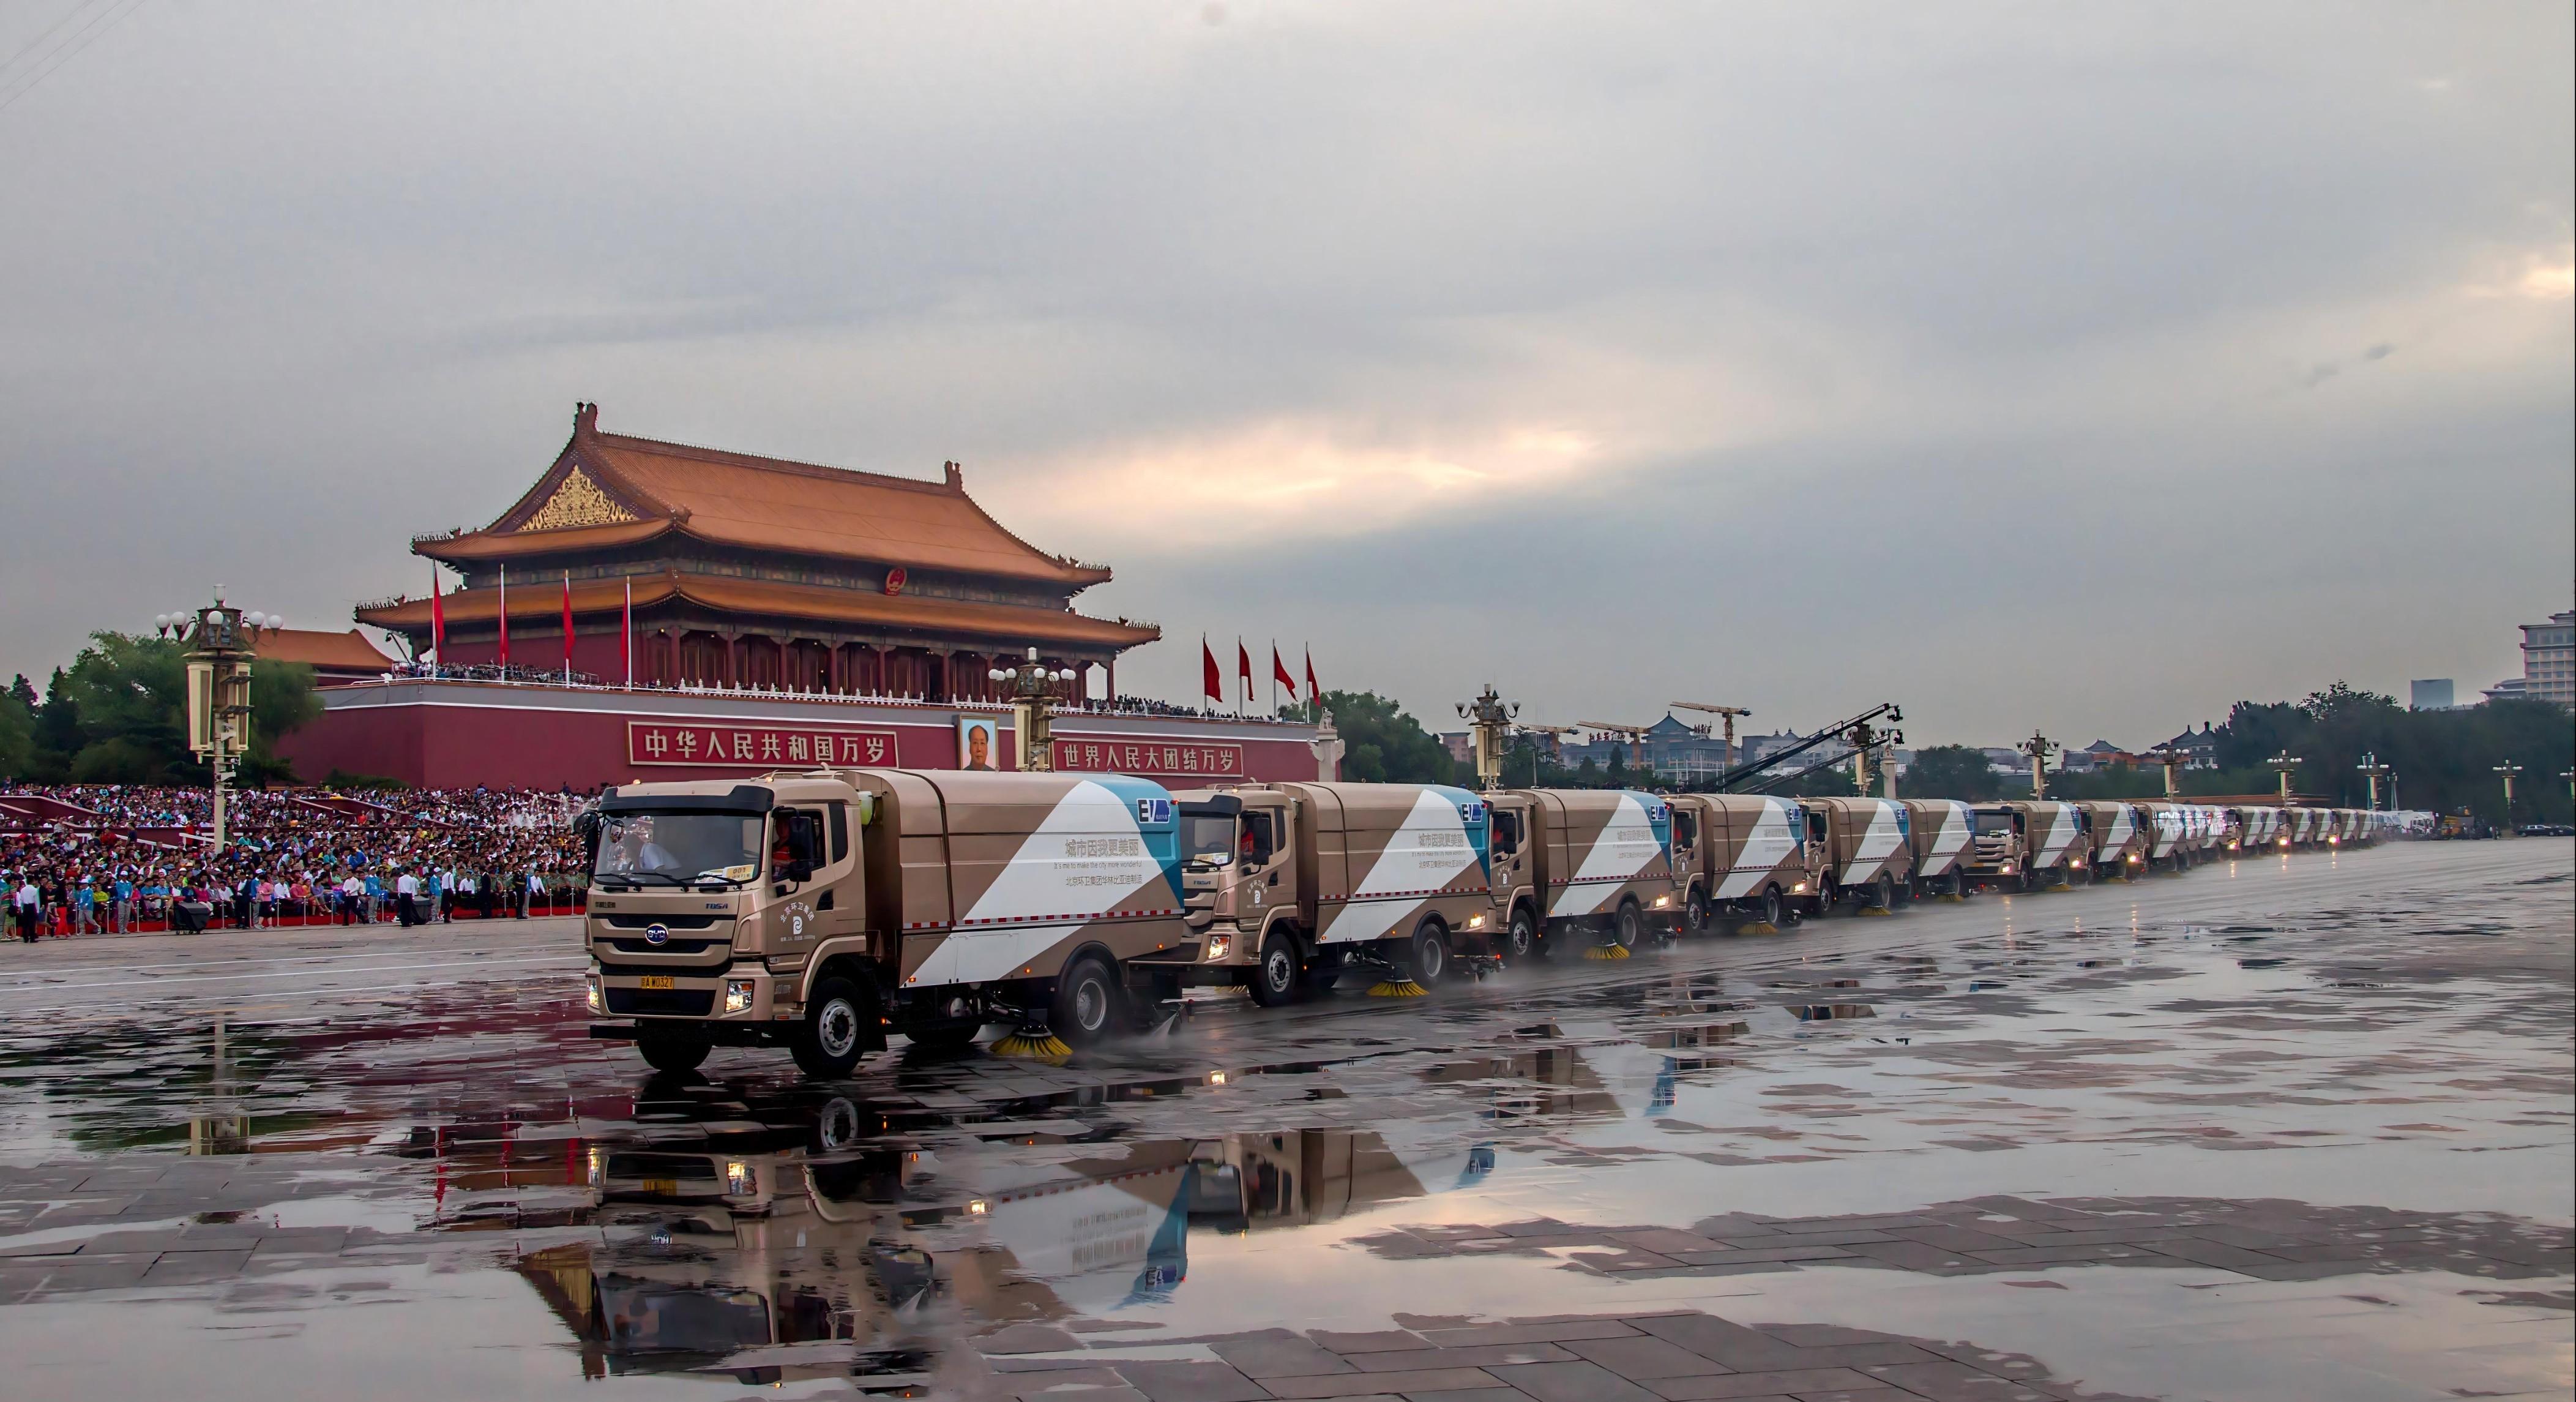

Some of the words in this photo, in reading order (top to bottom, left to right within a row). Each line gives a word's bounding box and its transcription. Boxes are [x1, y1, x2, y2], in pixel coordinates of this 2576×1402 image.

[645, 730, 884, 763] 中华人民共和国万岁
[1064, 744, 1233, 771] 世界人民大团结万岁
[1137, 798, 1157, 823] EV
[1461, 803, 1473, 822] EV
[1065, 838, 1139, 857] 城市因我更美丽
